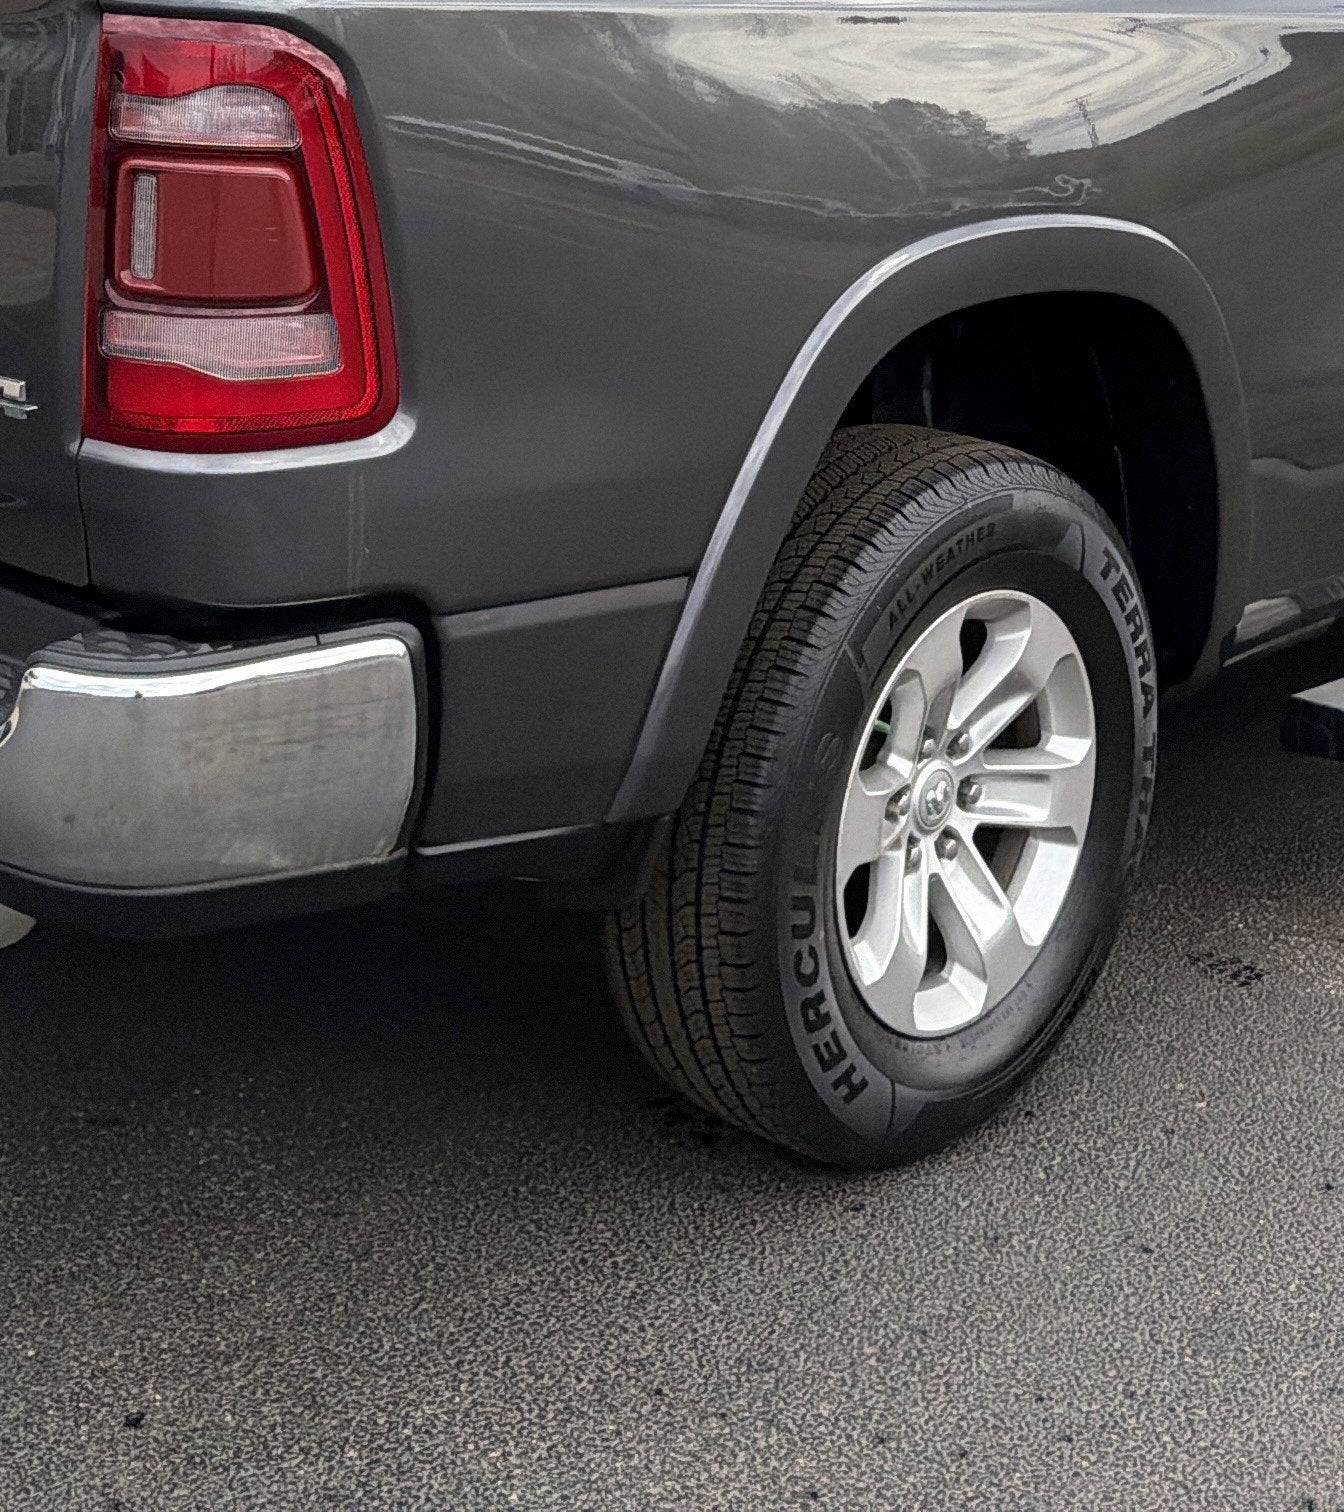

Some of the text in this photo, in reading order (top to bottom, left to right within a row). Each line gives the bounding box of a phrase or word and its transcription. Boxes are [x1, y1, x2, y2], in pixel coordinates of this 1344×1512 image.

[1099, 546, 1157, 866] TERRA TRA
[788, 806, 870, 1105] HERCUL
